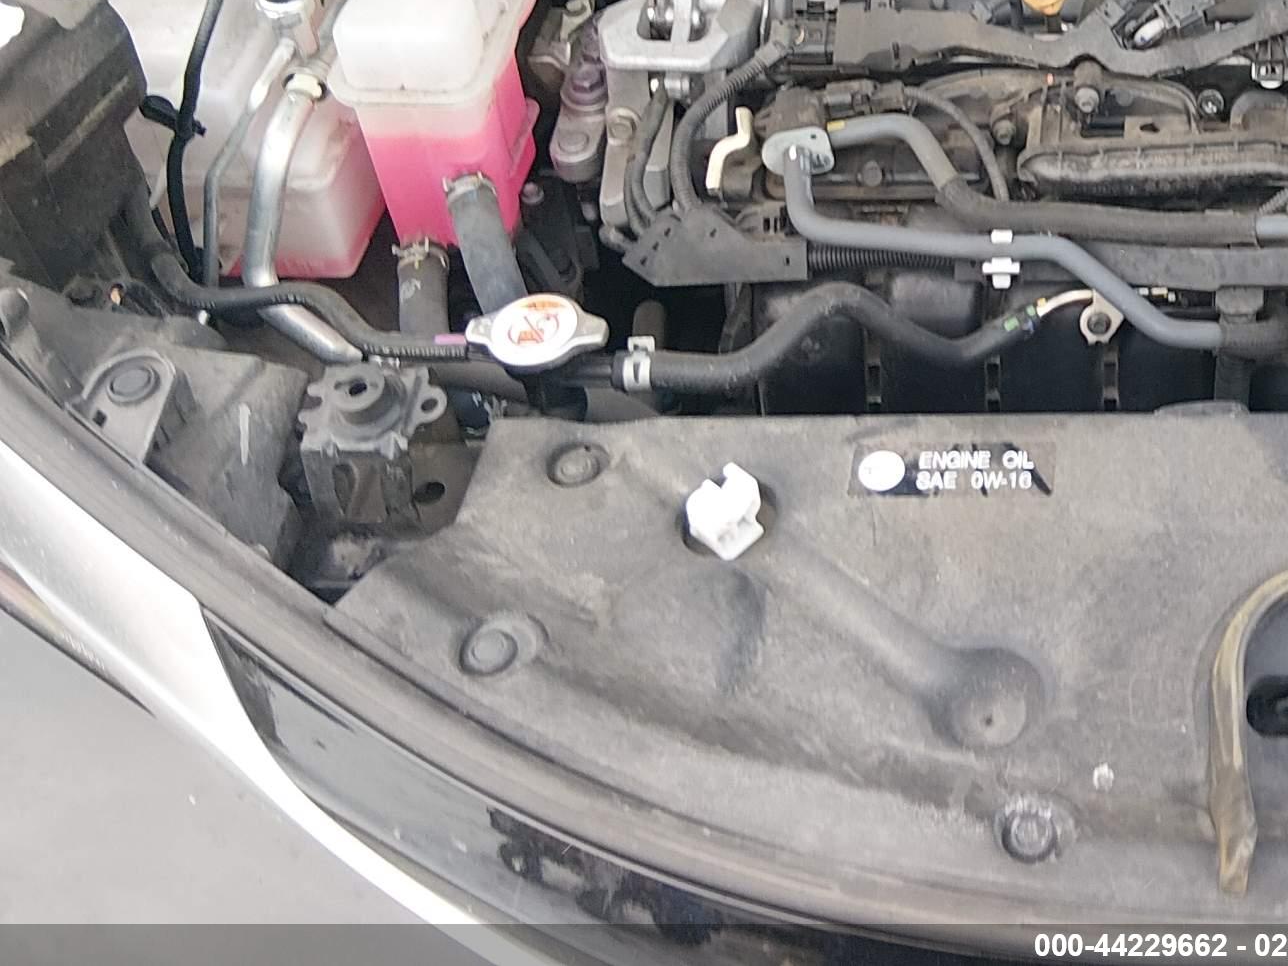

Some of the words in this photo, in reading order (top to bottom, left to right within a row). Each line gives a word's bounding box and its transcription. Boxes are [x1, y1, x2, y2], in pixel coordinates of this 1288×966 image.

[918, 449, 991, 470] ENGINE
[1002, 449, 1035, 470] OIL
[915, 470, 957, 491] SAE
